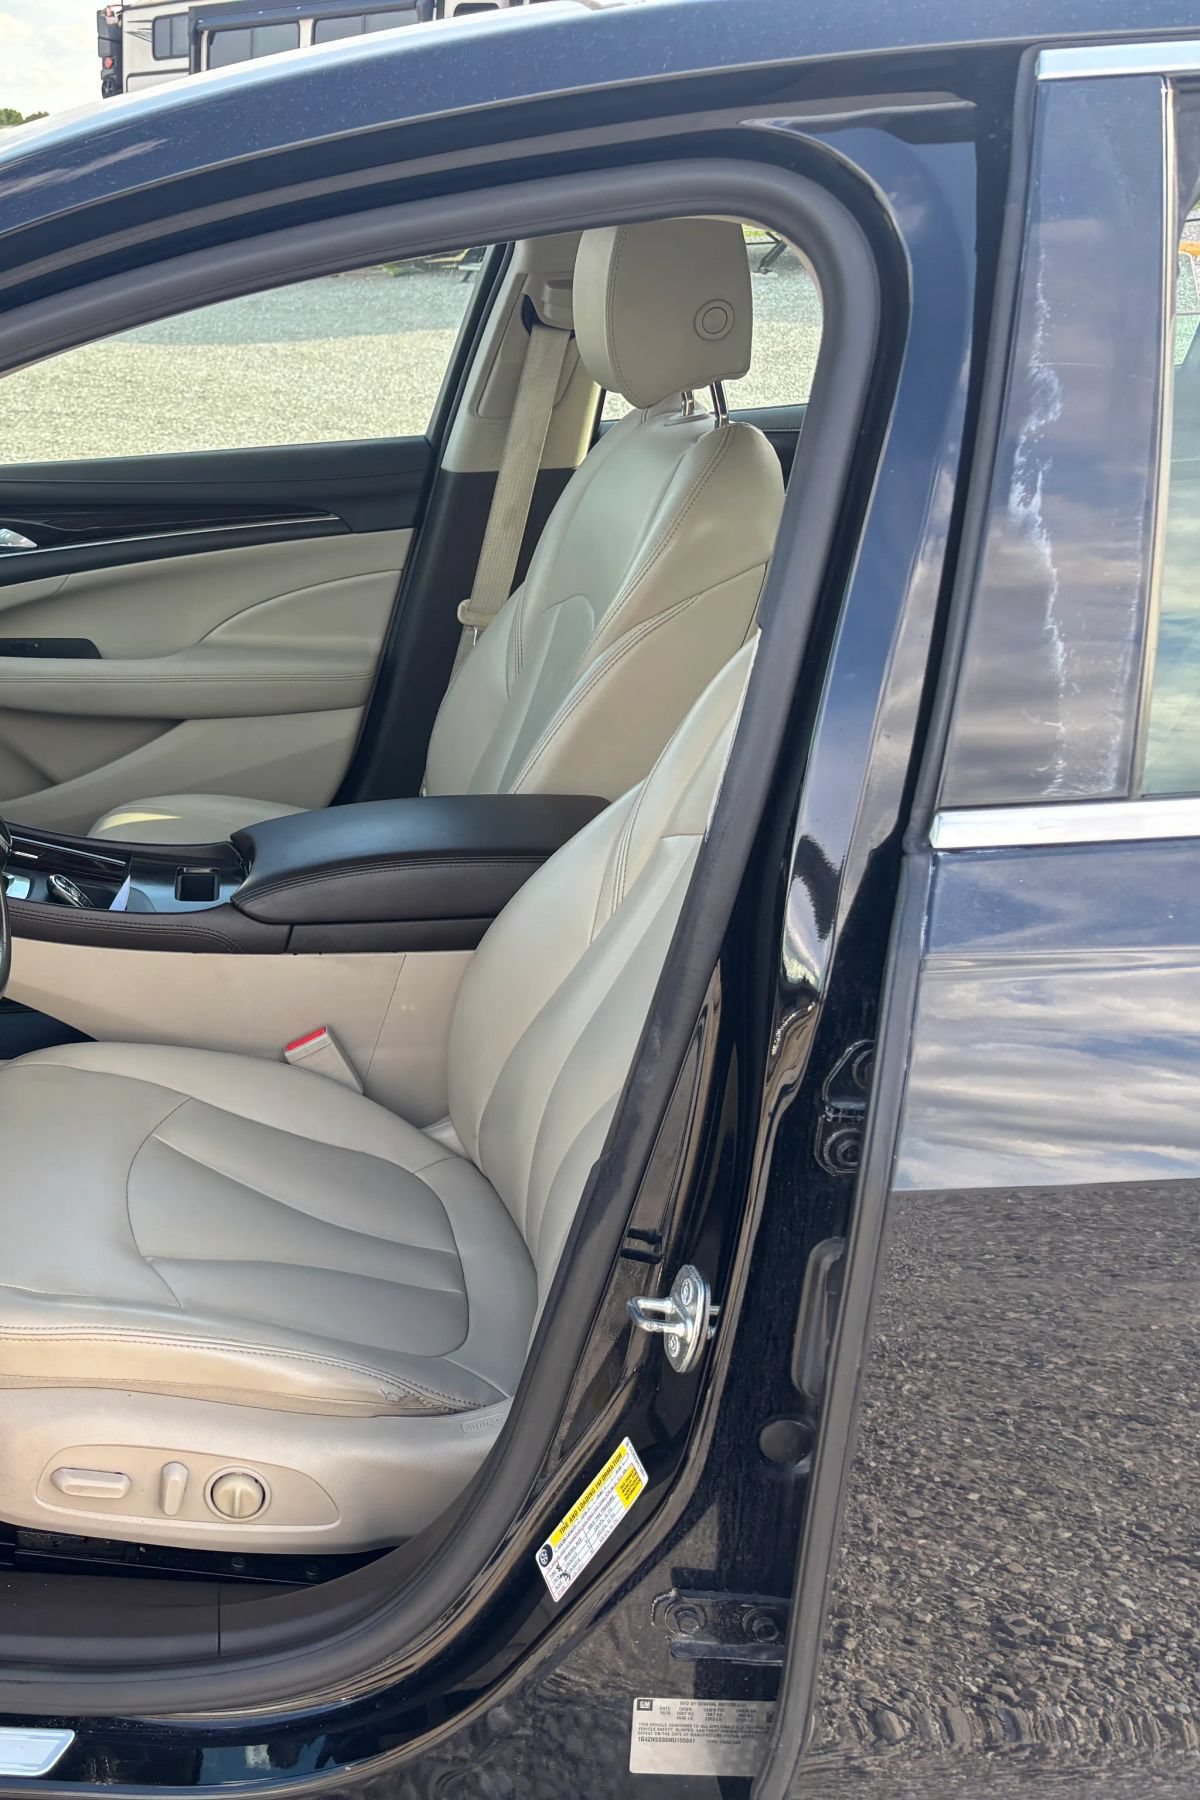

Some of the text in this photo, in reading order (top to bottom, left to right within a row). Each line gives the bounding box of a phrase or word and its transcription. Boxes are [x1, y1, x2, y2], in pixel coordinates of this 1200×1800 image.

[569, 1510, 579, 1522] AND
[577, 1487, 596, 1512] LOADING
[595, 1452, 623, 1490] INFORMATION
